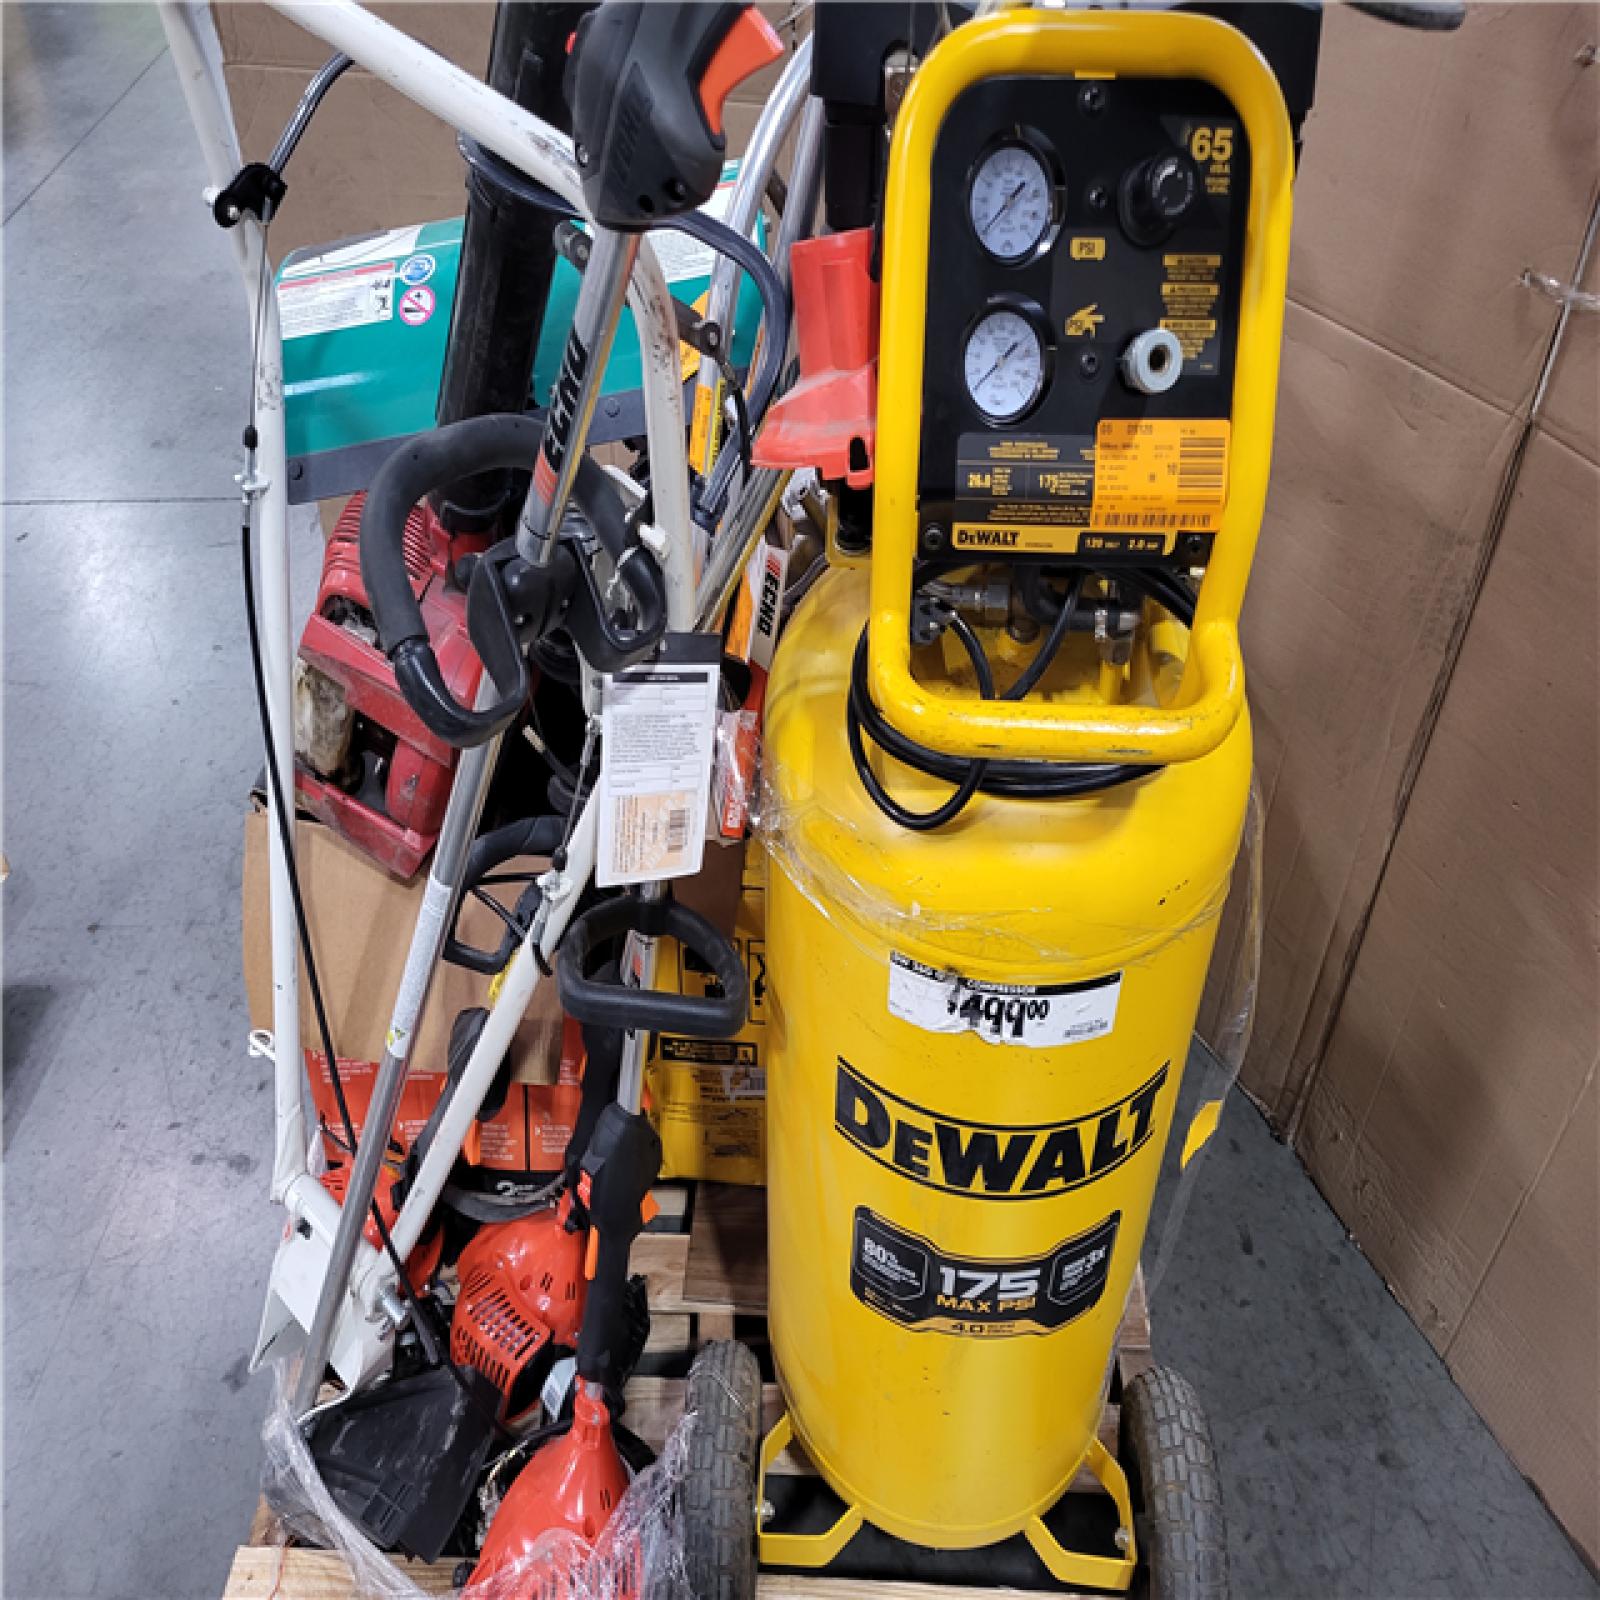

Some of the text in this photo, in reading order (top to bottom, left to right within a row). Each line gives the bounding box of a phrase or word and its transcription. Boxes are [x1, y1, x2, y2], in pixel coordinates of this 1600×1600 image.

[545, 328, 587, 474] ECHO
[836, 1063, 1168, 1193] DEWALT
[937, 1295, 990, 1313] MAX
[999, 1296, 1036, 1313] PSI
[940, 1265, 1041, 1301] 175
